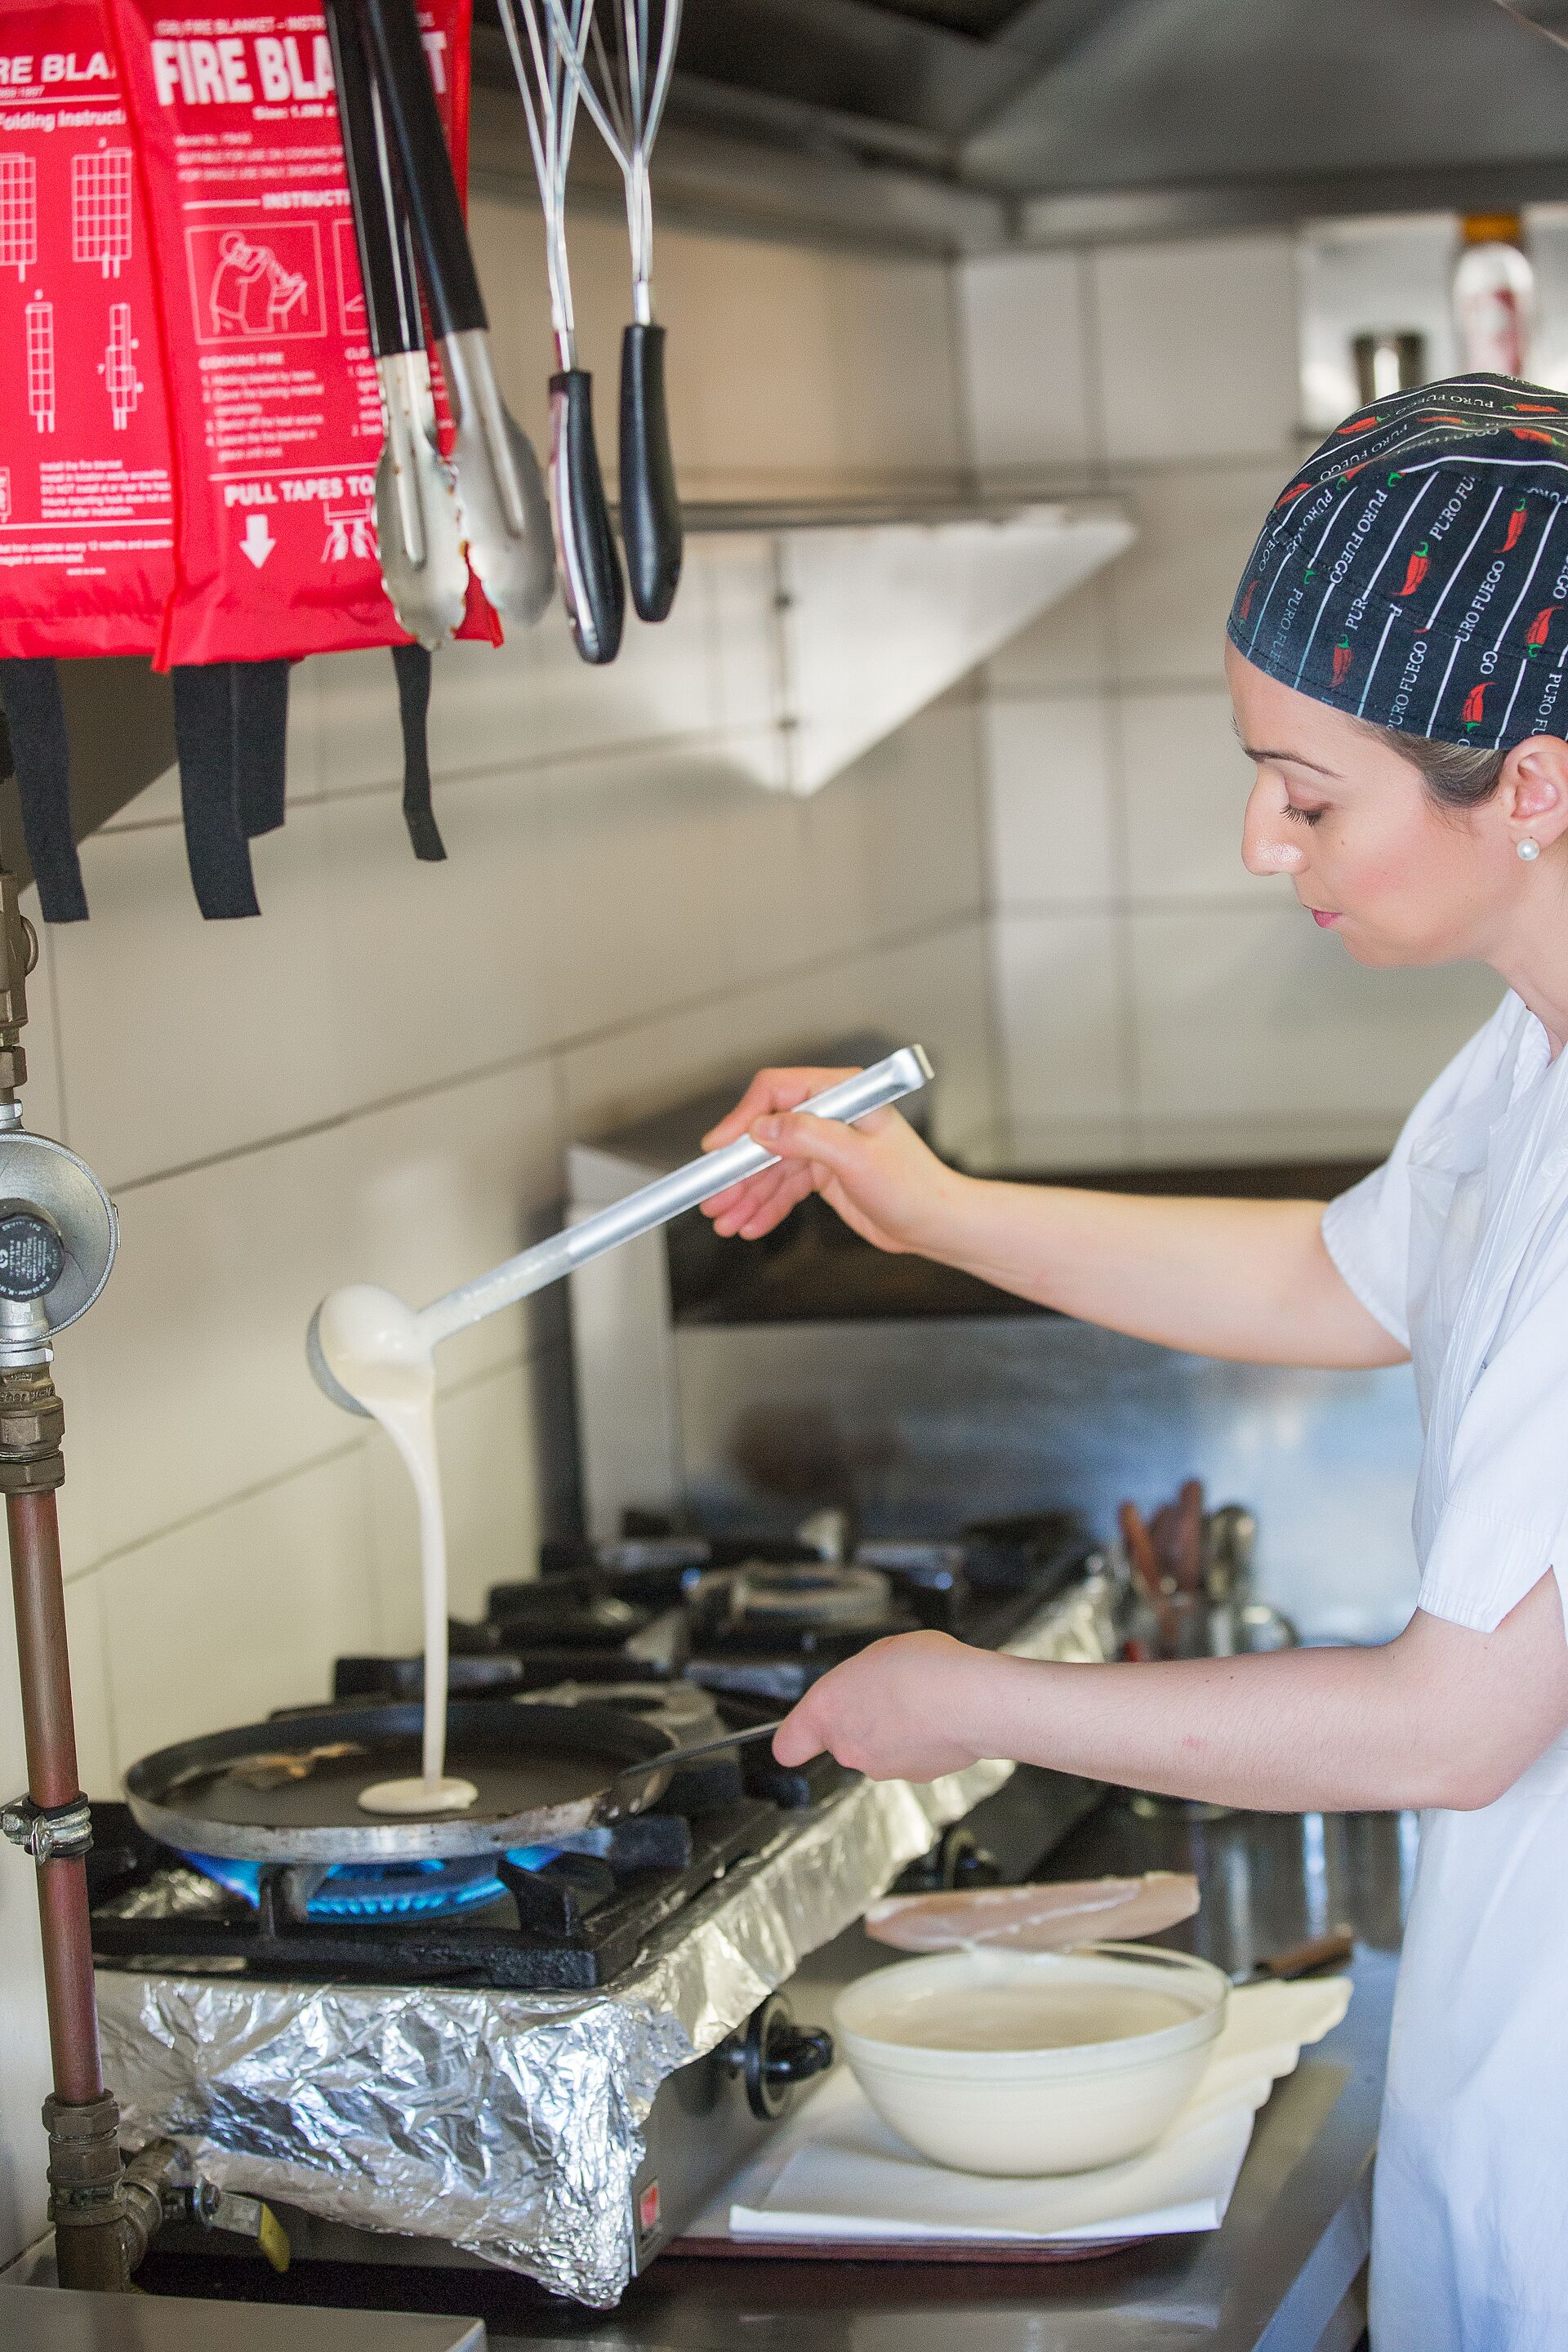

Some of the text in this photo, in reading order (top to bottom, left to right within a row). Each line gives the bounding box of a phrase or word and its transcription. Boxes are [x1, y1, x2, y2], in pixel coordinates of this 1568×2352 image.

[41, 51, 117, 82] BLA
[150, 39, 253, 105] FIRE
[262, 188, 351, 210] INSTRUCTI
[1450, 395, 1494, 408] PURO
[1320, 449, 1369, 482] FUEGO
[225, 483, 278, 507] PULL
[279, 477, 344, 502] TAPES
[1330, 489, 1388, 585] PURO FUEGO
[1429, 497, 1463, 541] PURO
[1280, 587, 1305, 630] PURO
[1345, 597, 1369, 631] PUR
[1454, 560, 1506, 643] URO FUEGO
[1399, 640, 1428, 692] FUEGO
[1539, 673, 1563, 716] PURO
